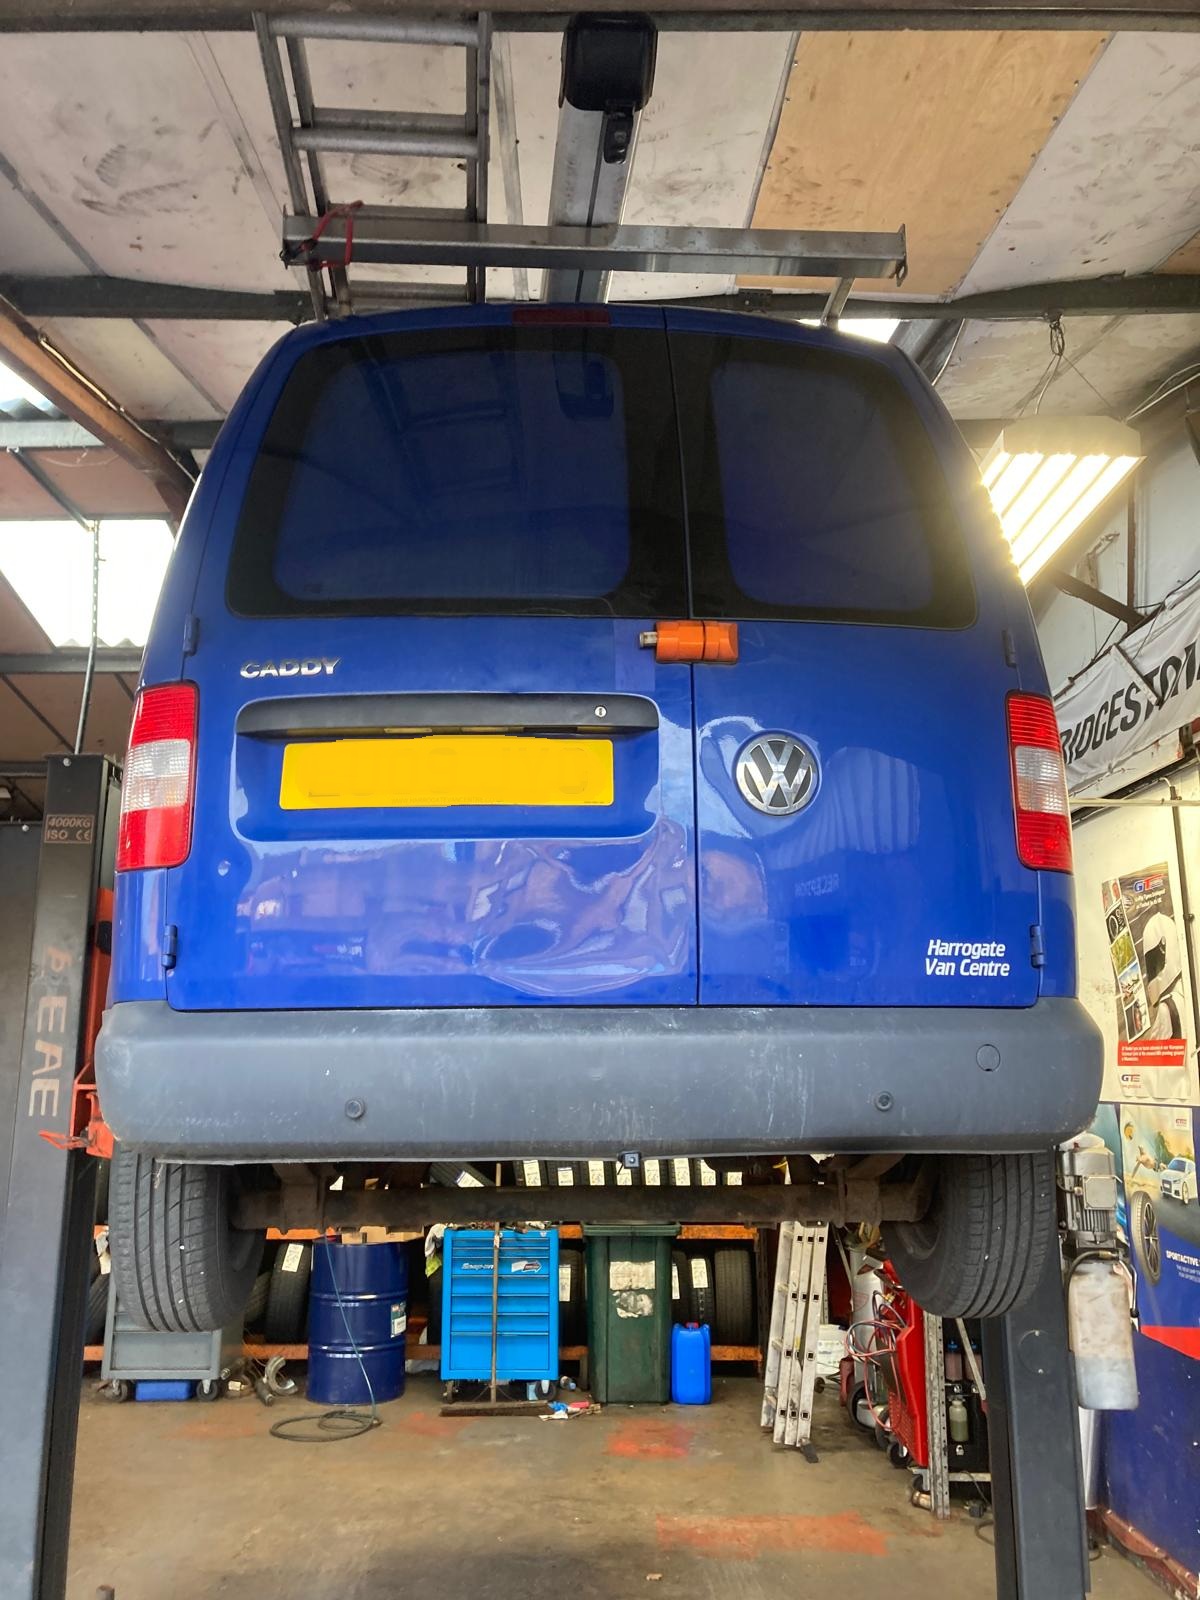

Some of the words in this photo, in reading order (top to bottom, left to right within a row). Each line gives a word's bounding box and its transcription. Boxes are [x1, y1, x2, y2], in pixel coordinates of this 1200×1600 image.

[240, 657, 342, 679] CADDY
[48, 815, 91, 828] 4000KG
[46, 830, 68, 840] ISO
[927, 939, 1006, 960] Harrogate
[925, 957, 956, 976] Van
[959, 958, 1010, 977] Centre
